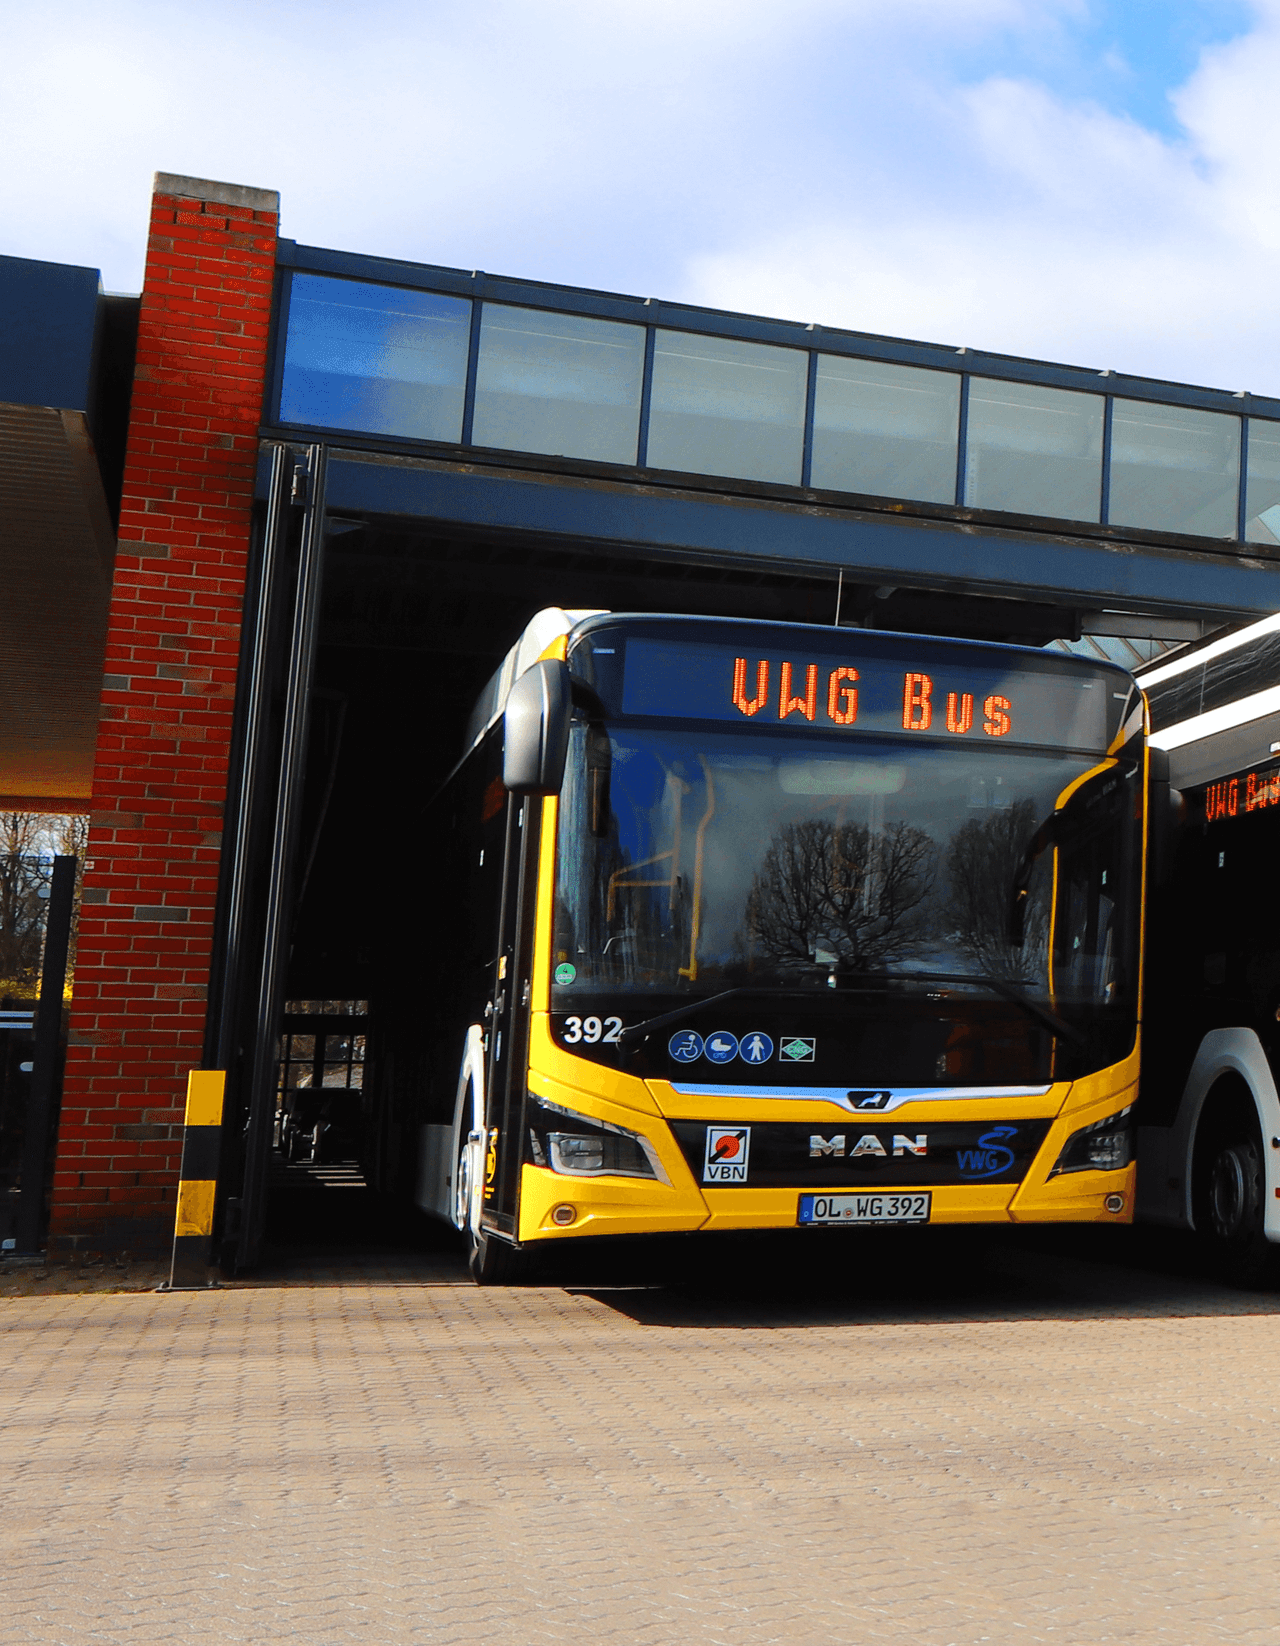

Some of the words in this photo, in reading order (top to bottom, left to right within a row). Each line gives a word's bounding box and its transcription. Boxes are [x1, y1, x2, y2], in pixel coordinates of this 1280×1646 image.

[732, 657, 860, 725] VWG
[902, 671, 1012, 737] Bus
[1206, 778, 1239, 822] VWG
[1245, 773, 1280, 812] Bus
[564, 1016, 624, 1044] 392
[809, 1134, 928, 1157] MAN
[957, 1150, 999, 1170] VWG
[708, 1165, 746, 1180] VBN
[814, 1198, 841, 1218] OL
[857, 1197, 883, 1217] WG
[887, 1197, 926, 1216] 392
